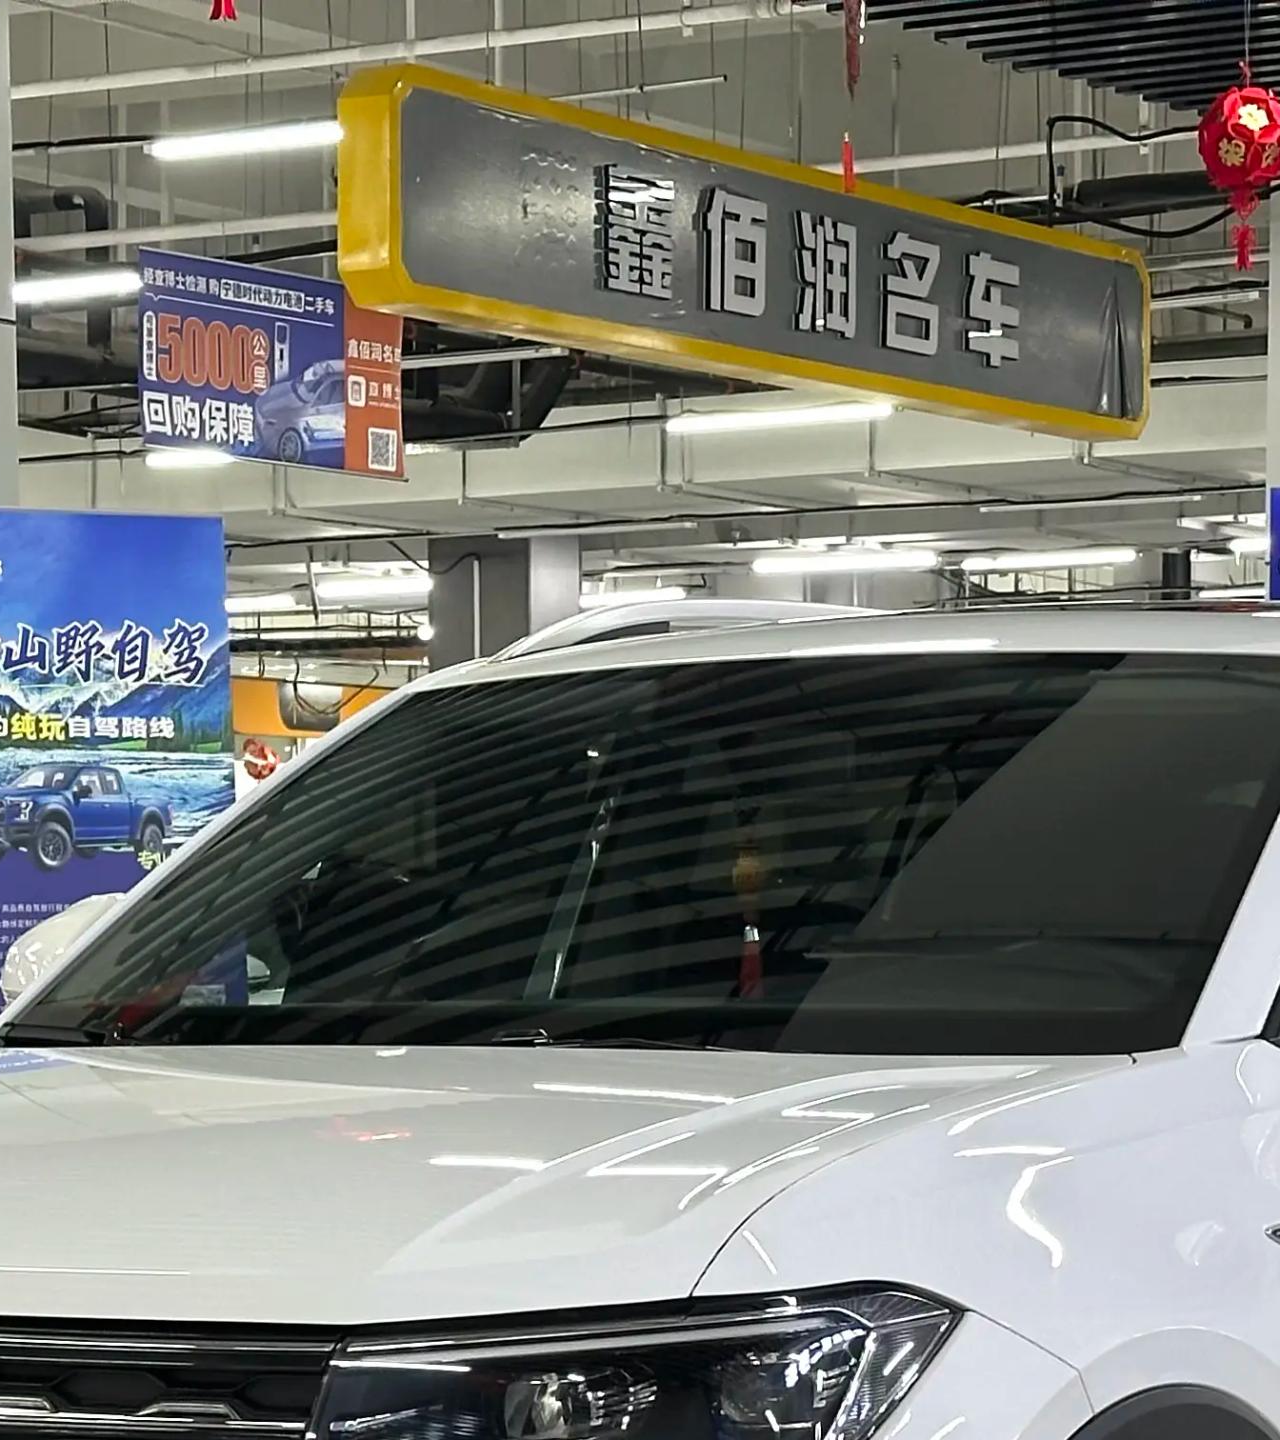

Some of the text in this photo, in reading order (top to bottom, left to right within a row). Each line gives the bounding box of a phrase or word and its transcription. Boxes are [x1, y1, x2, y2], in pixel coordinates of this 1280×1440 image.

[593, 162, 1022, 368] 鑫佰润名车
[143, 390, 255, 447] 回购保障
